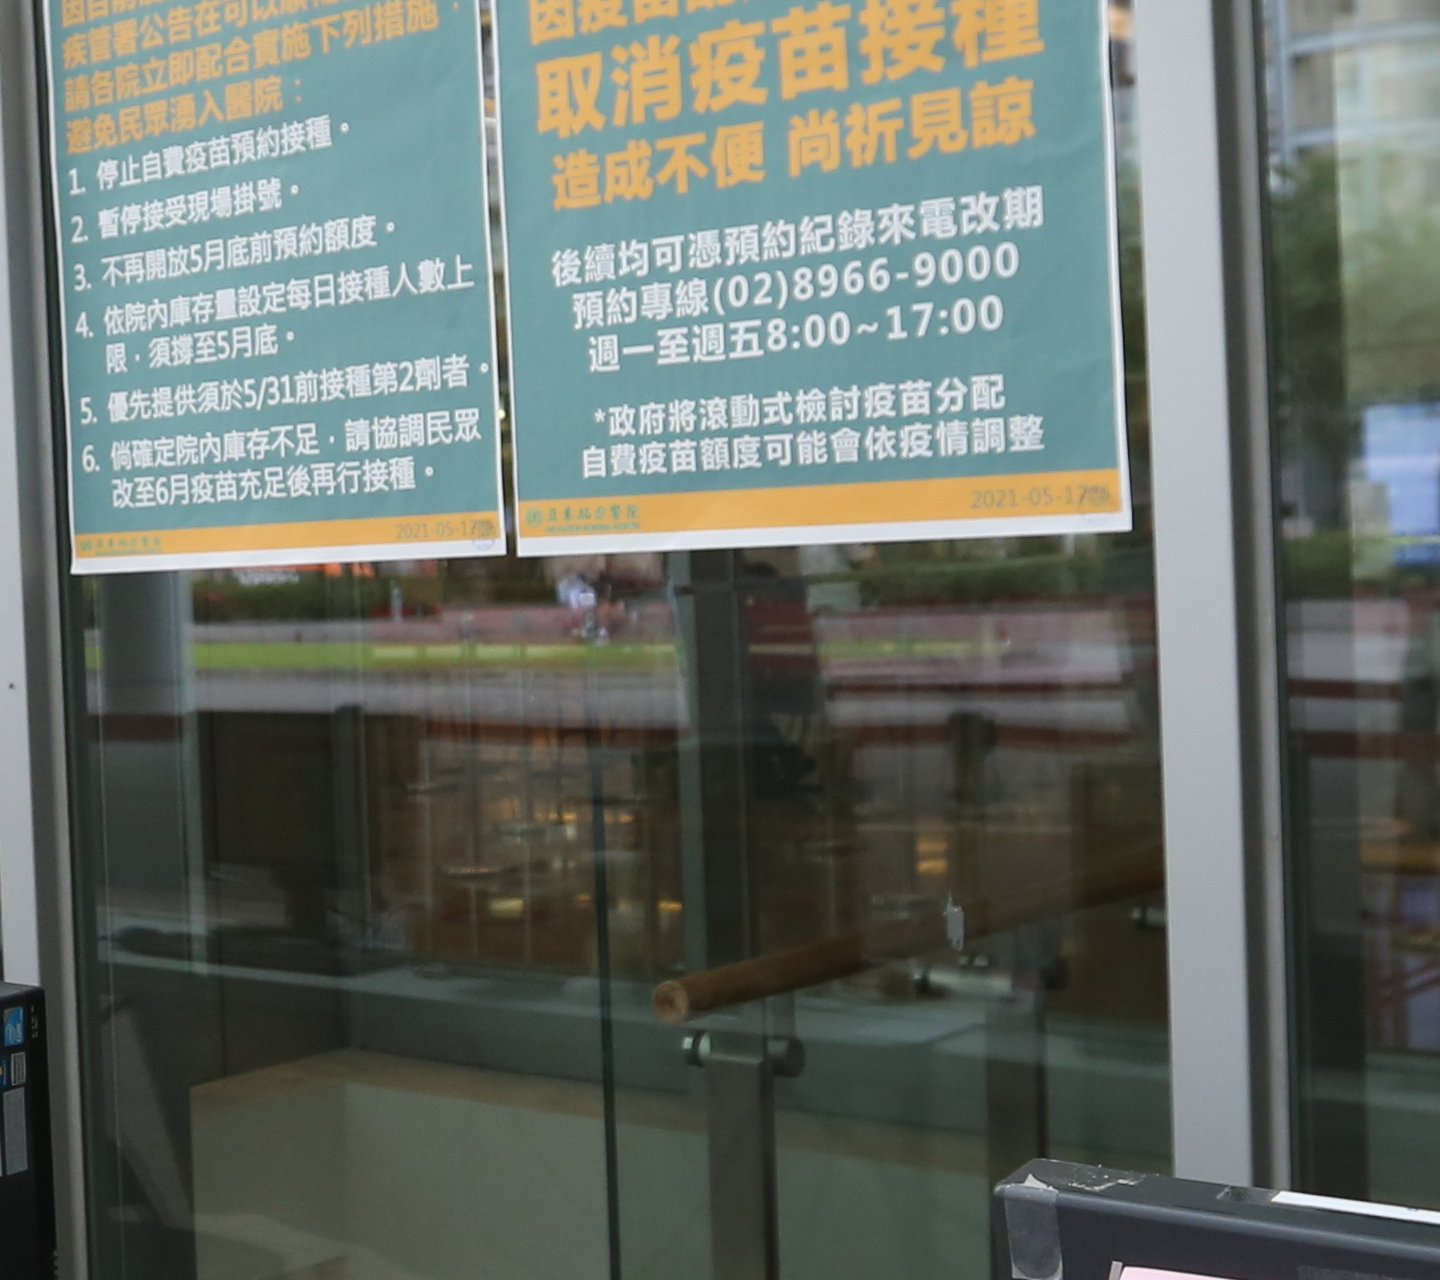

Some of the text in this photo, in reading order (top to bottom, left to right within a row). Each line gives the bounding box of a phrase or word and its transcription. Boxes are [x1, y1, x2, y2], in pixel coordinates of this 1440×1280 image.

[68, 114, 349, 196] 1. 停止自費疫苗預約接種。
[552, 77, 1036, 210] 造成不便 尚祈見諒
[71, 178, 299, 244] 2. 暫停接受現場掛號。
[551, 185, 1044, 287] 後續均可憑預約紀錄來電改期
[74, 215, 395, 292] 3. 不再開放5月底前預約額度。
[572, 241, 1020, 330] 預約專線(02)8966-9000
[76, 254, 475, 338] 4. 依院內庫存量設定每日接種人數上
[80, 397, 97, 424] 5.
[581, 415, 1045, 478] 自費疫苗額度可能會依疫情調整
[82, 445, 99, 472] 6.
[112, 456, 434, 509] 改至6月疫苗充足後再行接種。
